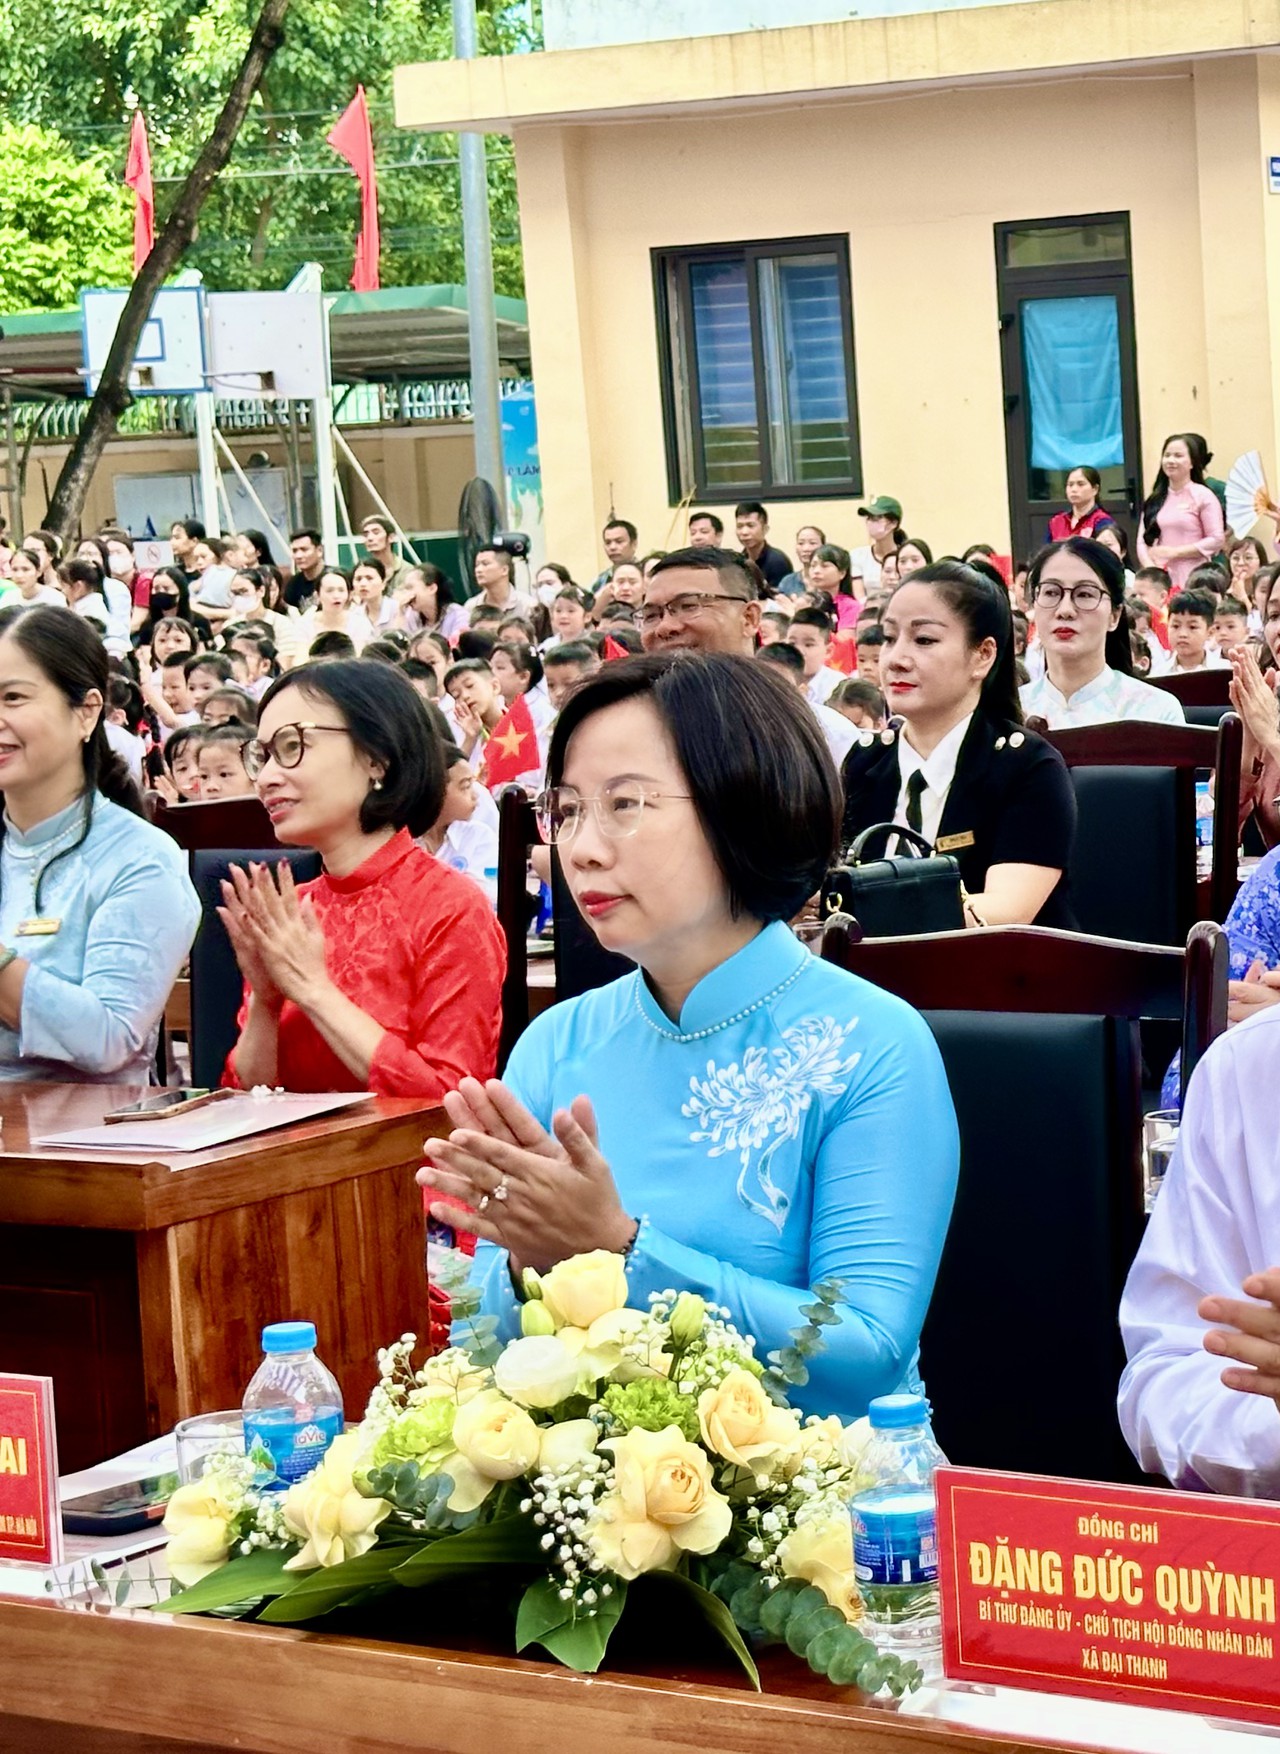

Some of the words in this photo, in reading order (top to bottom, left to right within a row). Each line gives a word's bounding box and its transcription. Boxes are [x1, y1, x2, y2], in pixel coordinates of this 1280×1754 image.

[1078, 1512, 1125, 1540] ĐỒNG
[1130, 1520, 1159, 1544] CHÍ
[968, 1536, 1063, 1598] ĐẶNG
[1073, 1548, 1144, 1606] ĐỨC
[1155, 1561, 1276, 1623] QUỲNH
[979, 1596, 992, 1620] BÍ
[994, 1602, 1019, 1625] THƯ
[1019, 1601, 1055, 1631] ĐẢNG
[1056, 1606, 1073, 1632] ỦY
[1084, 1609, 1110, 1636] CHỦ
[1111, 1617, 1141, 1649] TỊCH
[1144, 1618, 1166, 1649] HỘI
[1168, 1617, 1203, 1650] ĐỒNG
[1206, 1626, 1243, 1655] NHÂN
[1246, 1632, 1273, 1659] DÂN
[1082, 1646, 1100, 1670] XÃ
[1101, 1653, 1123, 1678] ĐẠI
[1126, 1656, 1168, 1680] THANH
